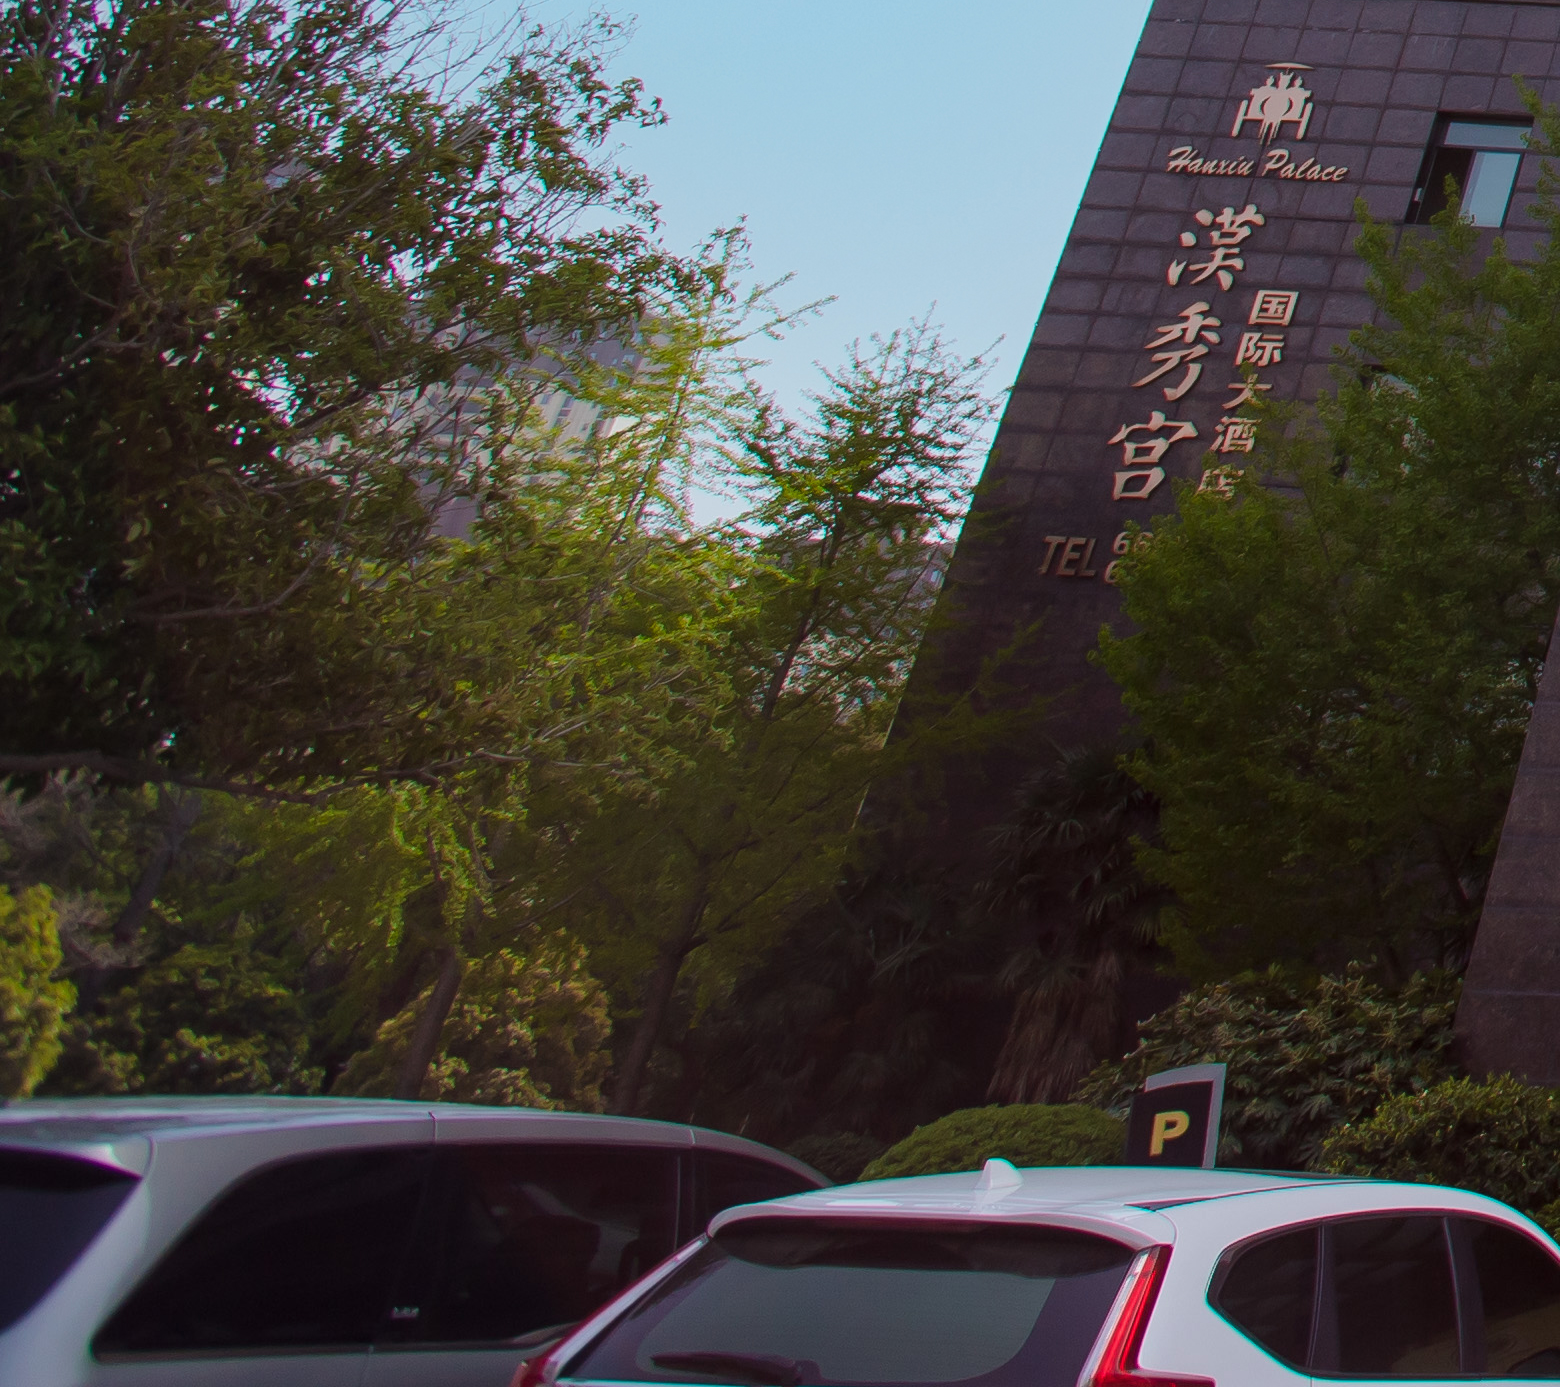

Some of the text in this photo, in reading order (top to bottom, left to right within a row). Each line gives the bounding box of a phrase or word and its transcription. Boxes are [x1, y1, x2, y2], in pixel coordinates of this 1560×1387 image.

[1165, 145, 1350, 182] Hanxiu Palace
[1038, 535, 1097, 578] TEL
[1149, 1110, 1190, 1156] P
